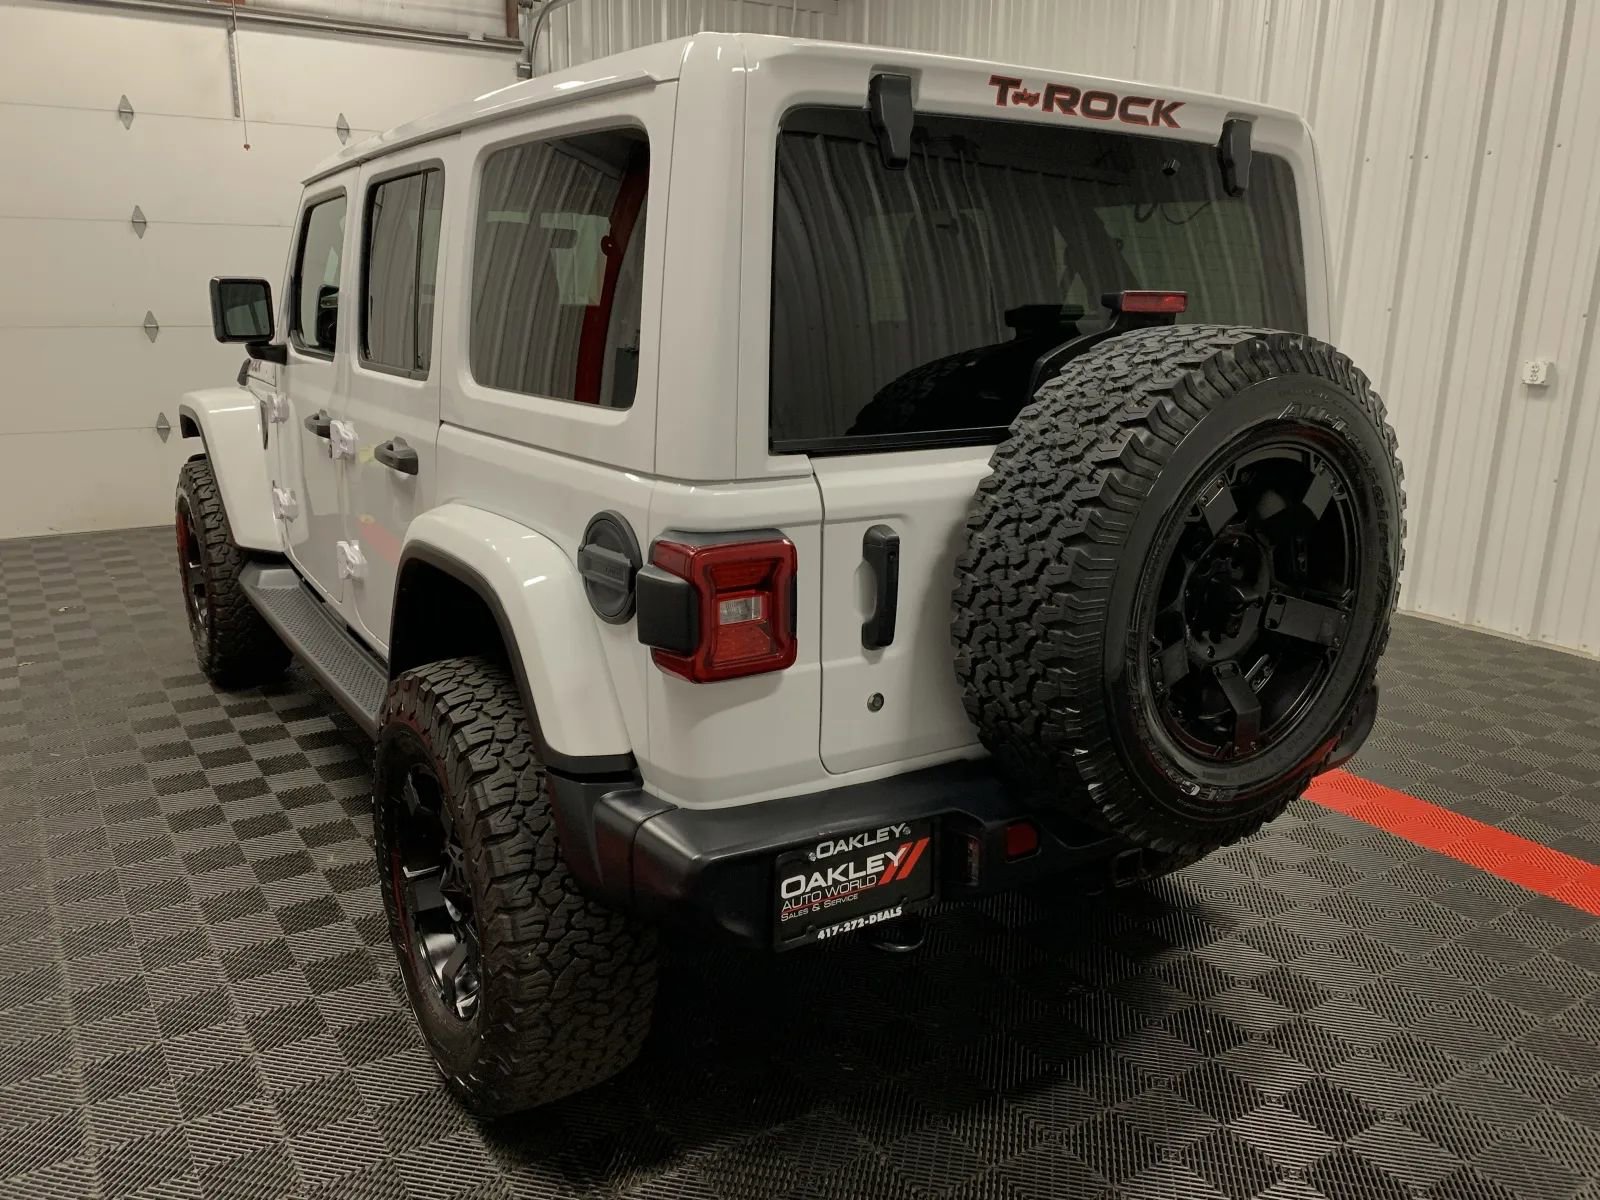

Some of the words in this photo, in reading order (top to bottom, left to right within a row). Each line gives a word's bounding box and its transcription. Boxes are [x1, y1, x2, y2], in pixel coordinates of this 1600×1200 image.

[816, 823, 906, 859] OAKLEY
[780, 847, 907, 899] OAKLEY
[781, 890, 821, 912] AUTO
[825, 874, 877, 898] WORLD
[812, 902, 821, 912] &
[817, 906, 903, 940] 417-272-DEALS
